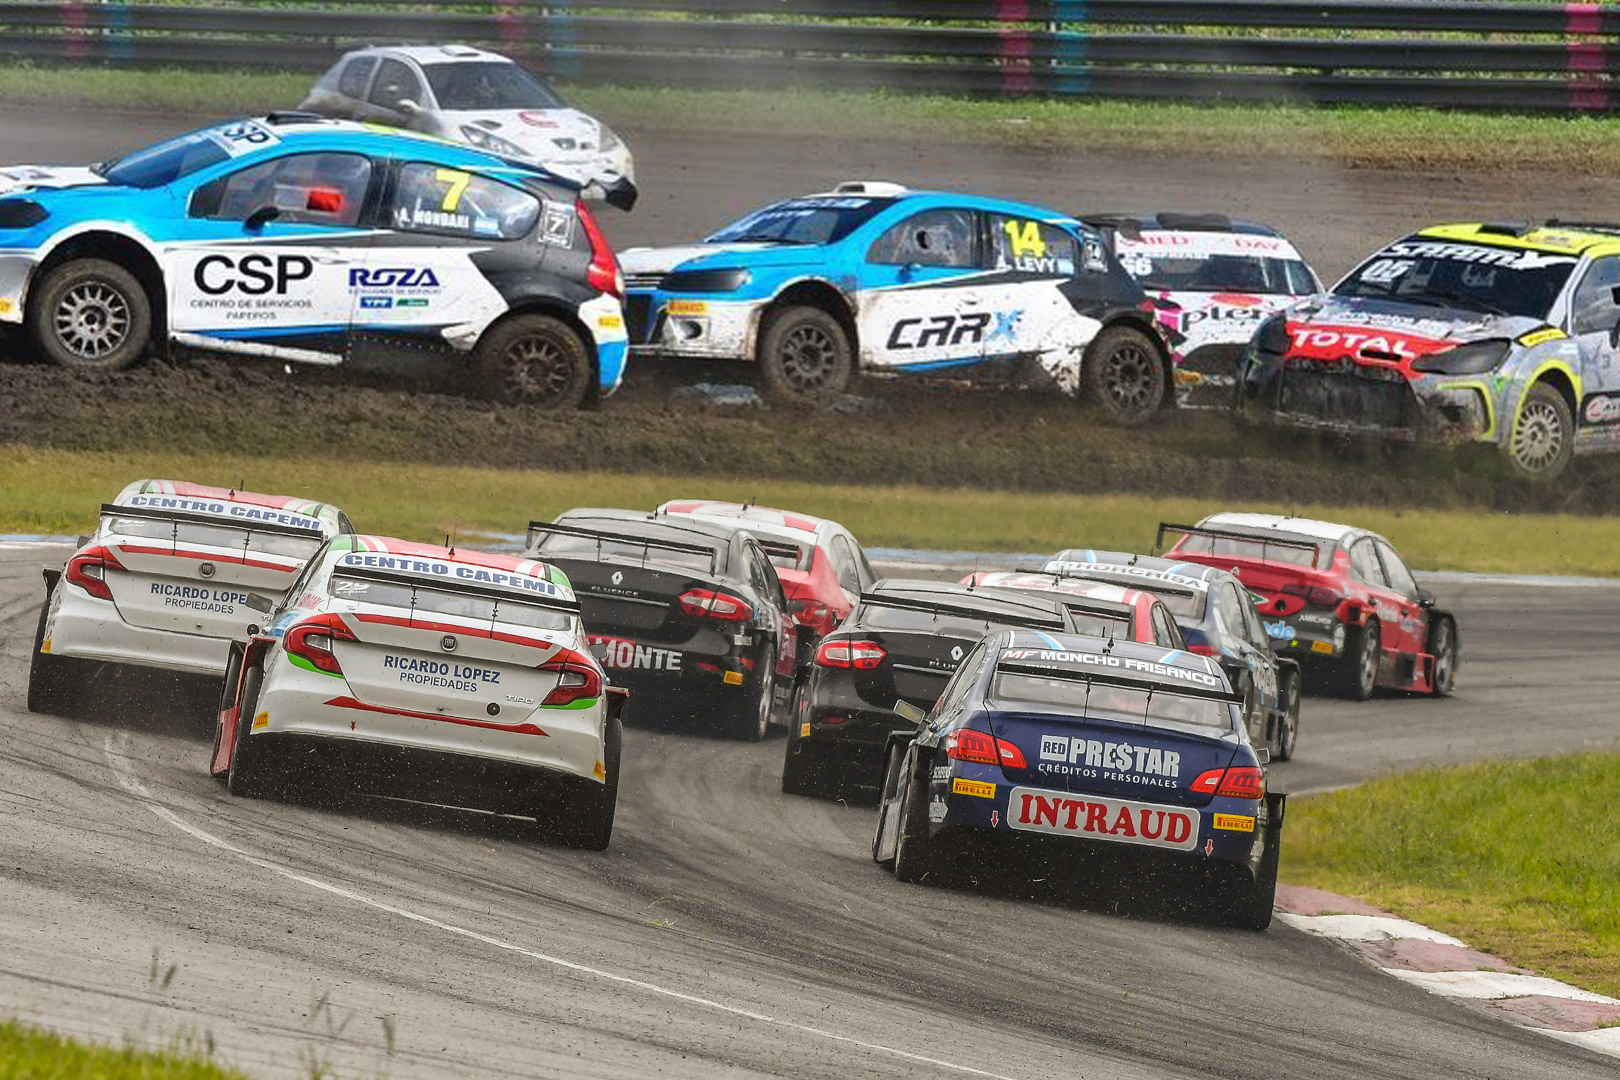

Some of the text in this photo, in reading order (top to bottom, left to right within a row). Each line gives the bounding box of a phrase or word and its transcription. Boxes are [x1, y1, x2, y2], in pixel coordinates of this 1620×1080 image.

[436, 169, 471, 211] 7
[551, 216, 566, 233] 7
[1005, 219, 1046, 257] 14
[1235, 238, 1282, 251] DAY
[194, 254, 313, 295] CSP
[1015, 257, 1055, 273] LEVY
[349, 268, 440, 287] ROZA
[190, 299, 312, 308] CENTRO DE SERVICIOS
[886, 311, 1020, 350] CARX
[1293, 329, 1416, 358] TOTAL
[131, 496, 320, 530] CENTRO CAPEMI
[344, 554, 556, 596] CENTRO CAPEMI
[151, 583, 247, 605] RICARDO LOPE
[165, 597, 234, 615] PROPIEDADES
[384, 655, 501, 684] RICARDO LOPEZ
[1001, 651, 1216, 686] MF MONCHO FRISANCO
[400, 672, 478, 693] PROPIEDADES
[505, 694, 534, 705] TIPO
[1042, 742, 1067, 755] RED
[1038, 763, 1178, 789] CRÉDITOS PERSONALES
[954, 781, 993, 796] PIRELLI
[1018, 794, 1192, 843] INTRAUD
[1217, 816, 1253, 830] PIRELLI
